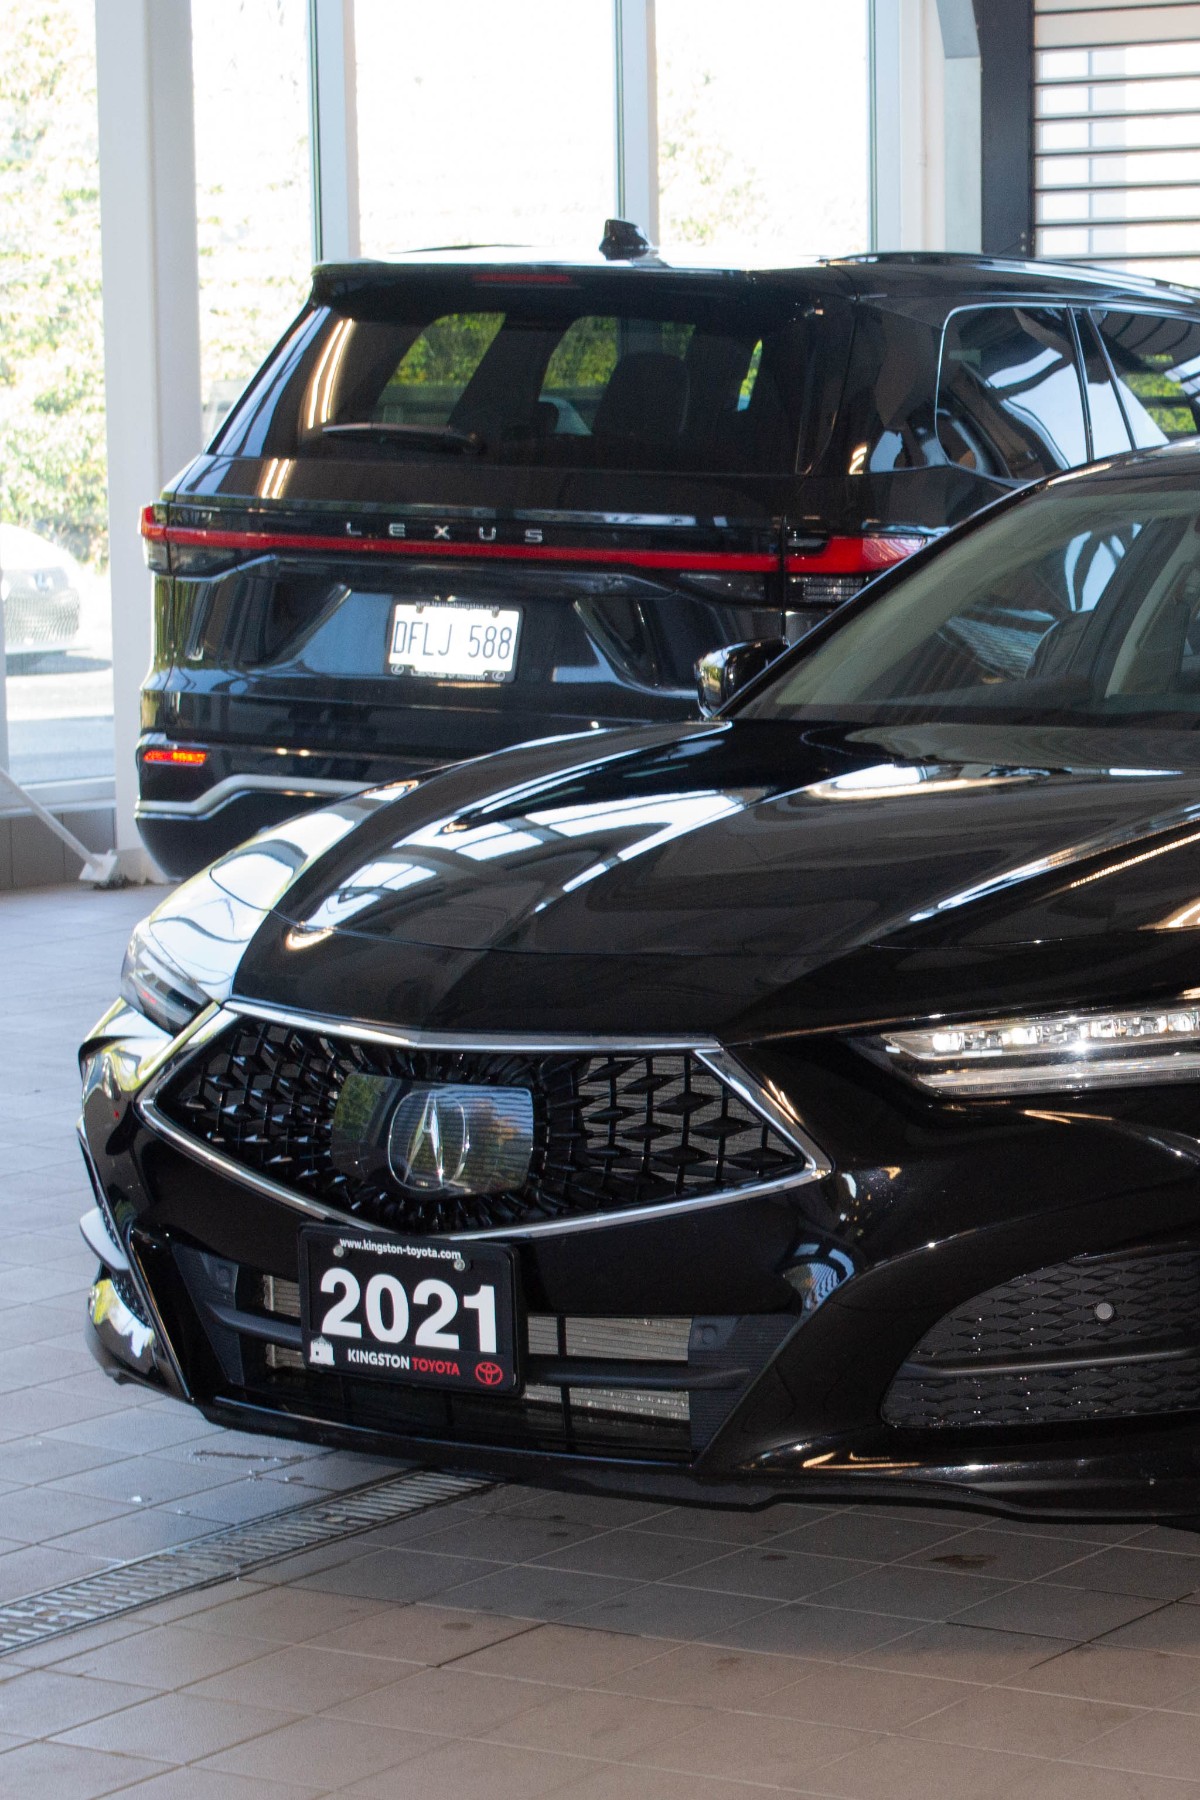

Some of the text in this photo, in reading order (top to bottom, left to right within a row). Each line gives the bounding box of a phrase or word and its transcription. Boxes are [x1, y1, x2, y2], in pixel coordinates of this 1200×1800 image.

[346, 522, 543, 543] LEXUS
[392, 621, 513, 660] DFLJ 588
[339, 1238, 461, 1260] www.kingston-toyota.com
[320, 1267, 497, 1354] 2021
[347, 1349, 460, 1376] KINGSTON TOYOTA
